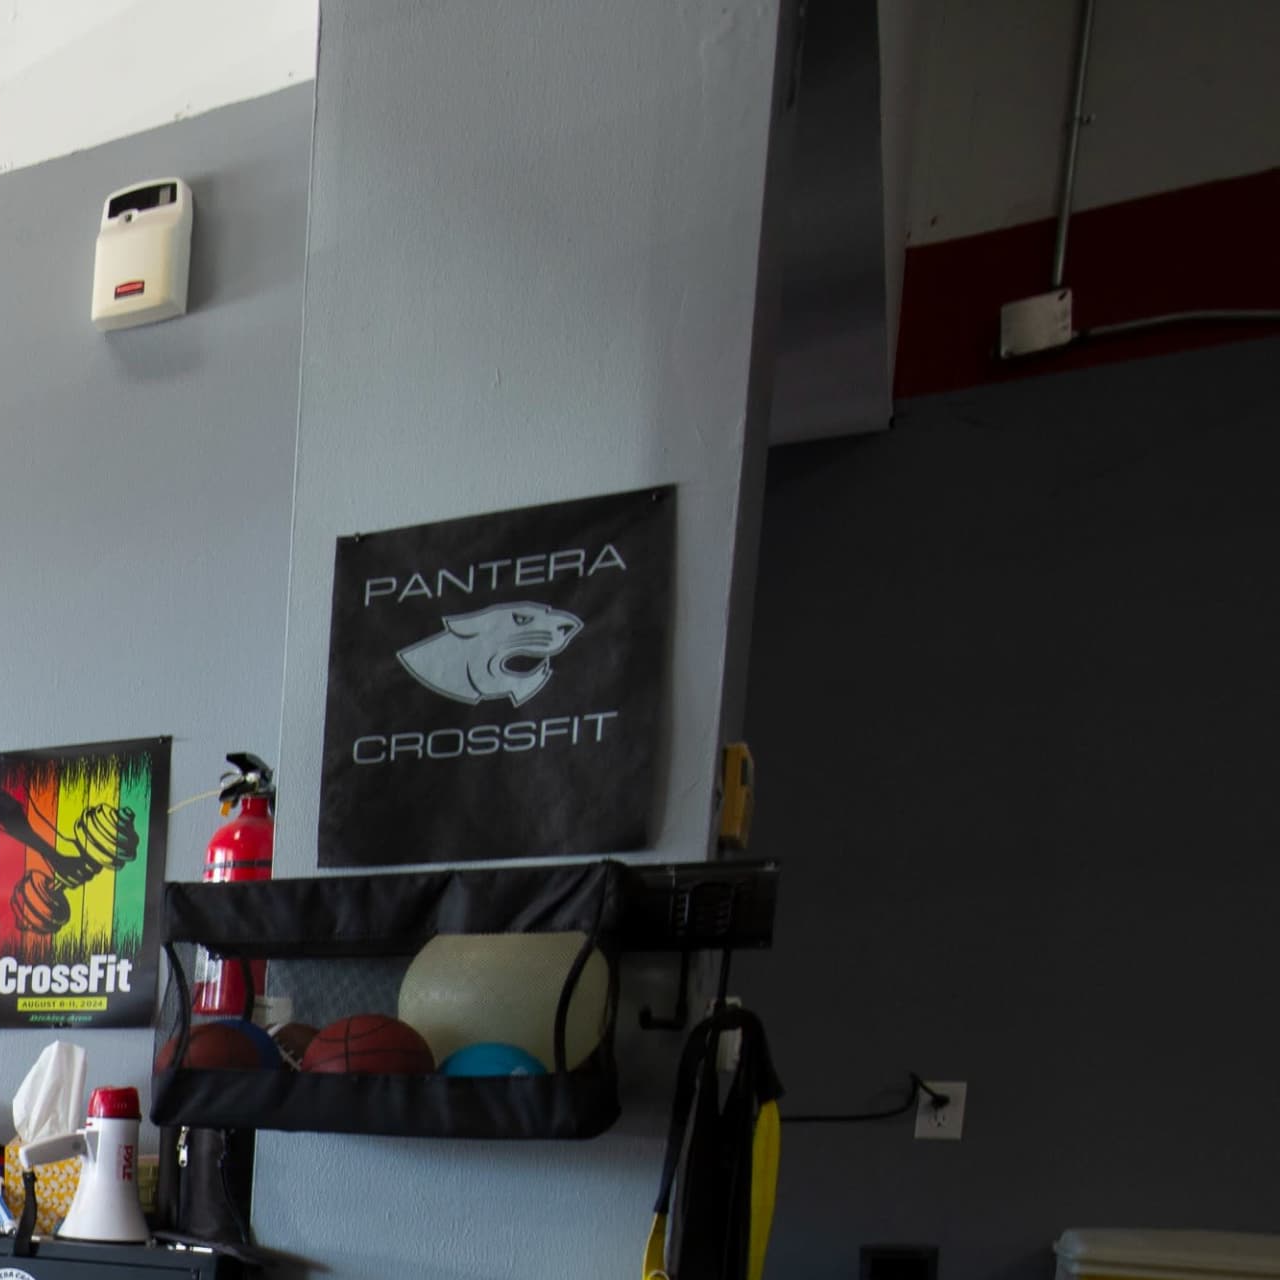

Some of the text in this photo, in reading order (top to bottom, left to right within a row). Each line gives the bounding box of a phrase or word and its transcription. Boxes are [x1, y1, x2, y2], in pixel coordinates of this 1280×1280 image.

[364, 544, 627, 607] PANTERA
[352, 711, 618, 765] CROSSFIT
[22, 999, 56, 1009] AUGUST
[80, 999, 102, 1008] 2024
